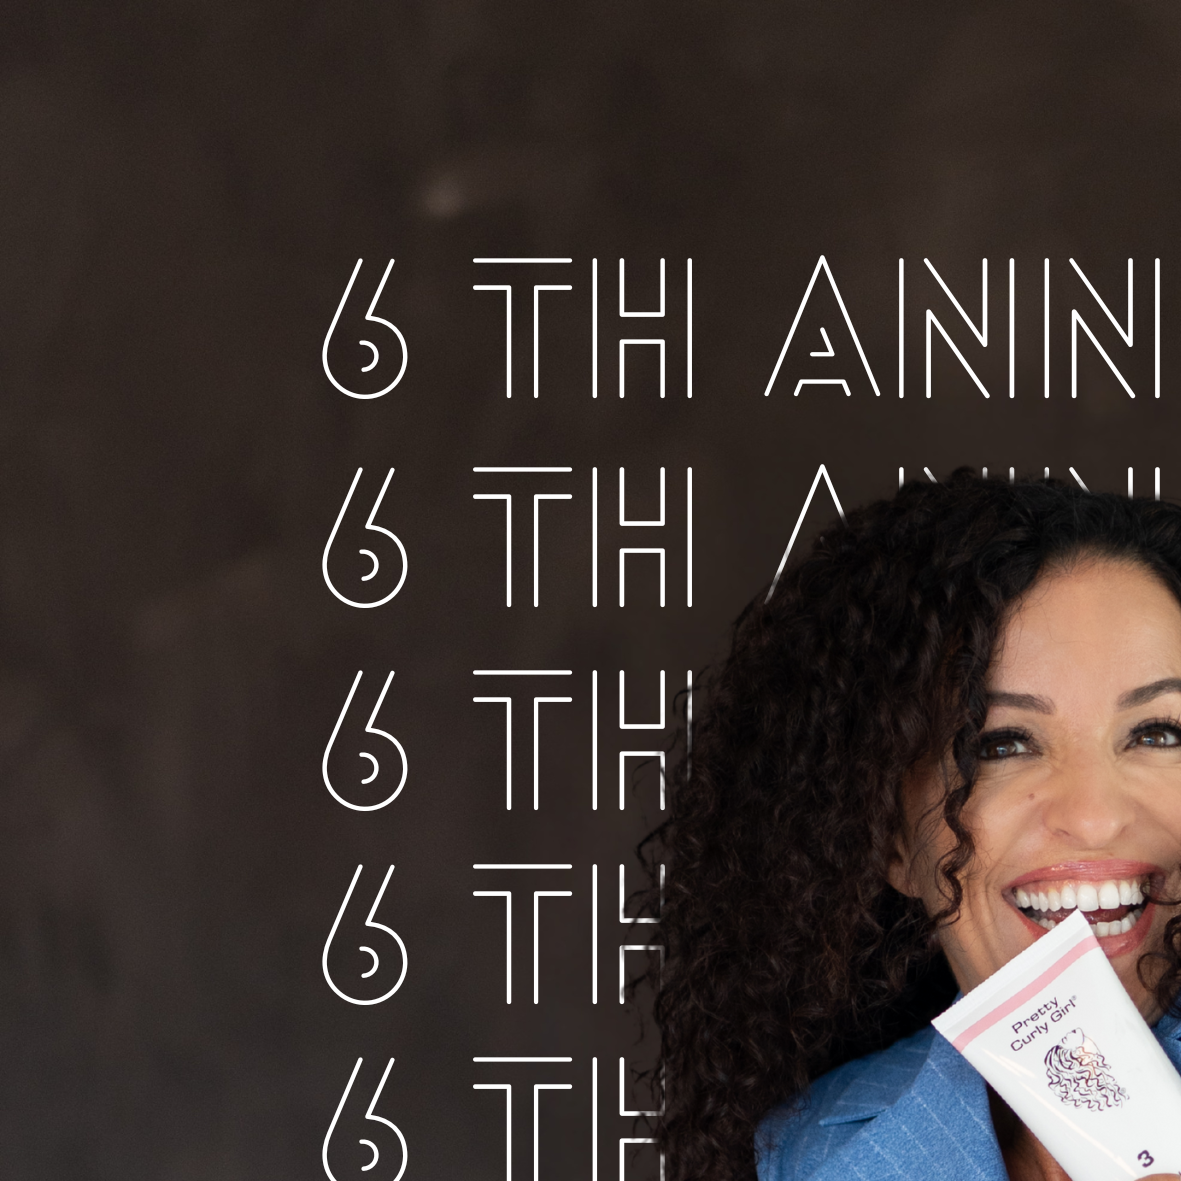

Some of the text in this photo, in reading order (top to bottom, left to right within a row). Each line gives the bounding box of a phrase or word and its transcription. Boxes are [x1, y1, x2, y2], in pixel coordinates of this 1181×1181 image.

[1012, 997, 1058, 1034] Pretty
[1010, 1022, 1049, 1051] Curly
[1137, 1150, 1154, 1168] 3
